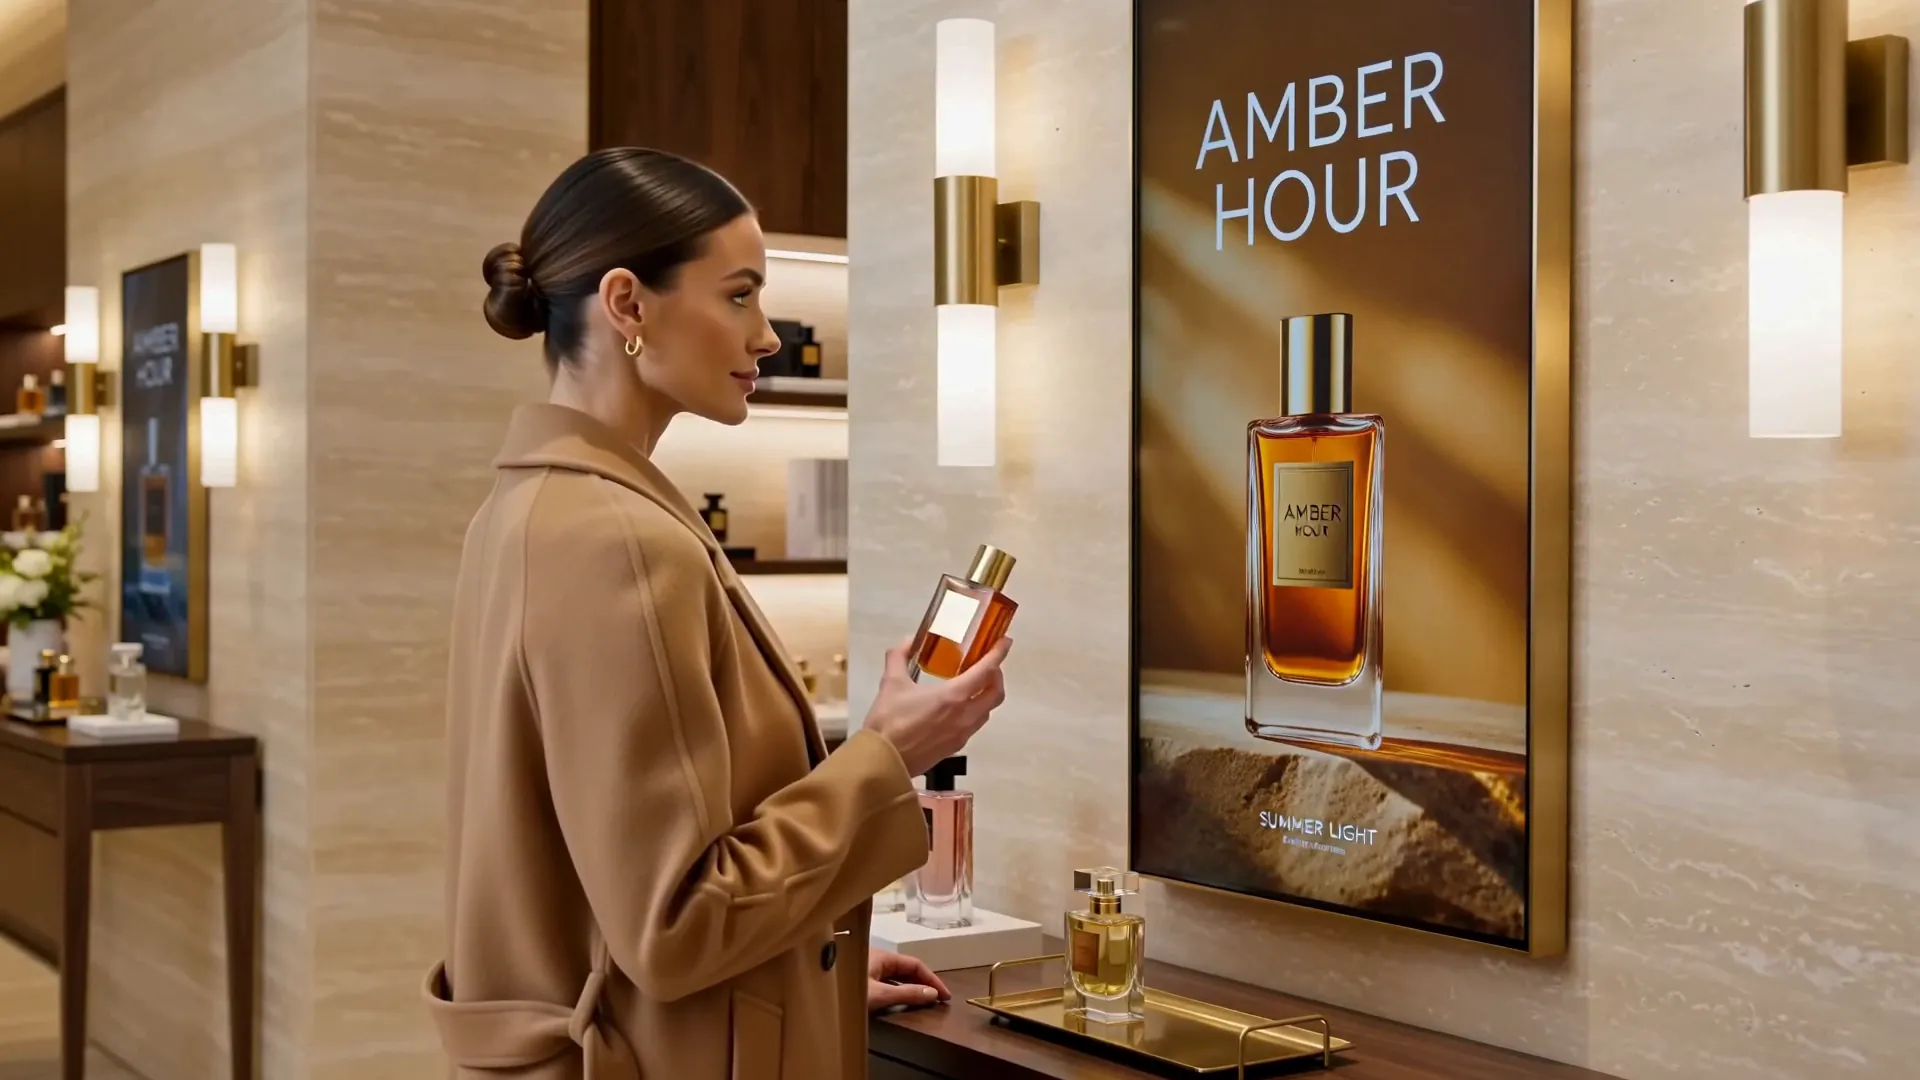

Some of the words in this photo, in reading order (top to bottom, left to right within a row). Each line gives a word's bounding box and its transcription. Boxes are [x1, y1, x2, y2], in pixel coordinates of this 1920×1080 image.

[1195, 51, 1446, 170] AMBER
[1216, 150, 1420, 251] HOUR
[1284, 504, 1342, 522] AMBER
[1259, 811, 1324, 836] SUMMER
[1329, 821, 1379, 846] LIGHT
